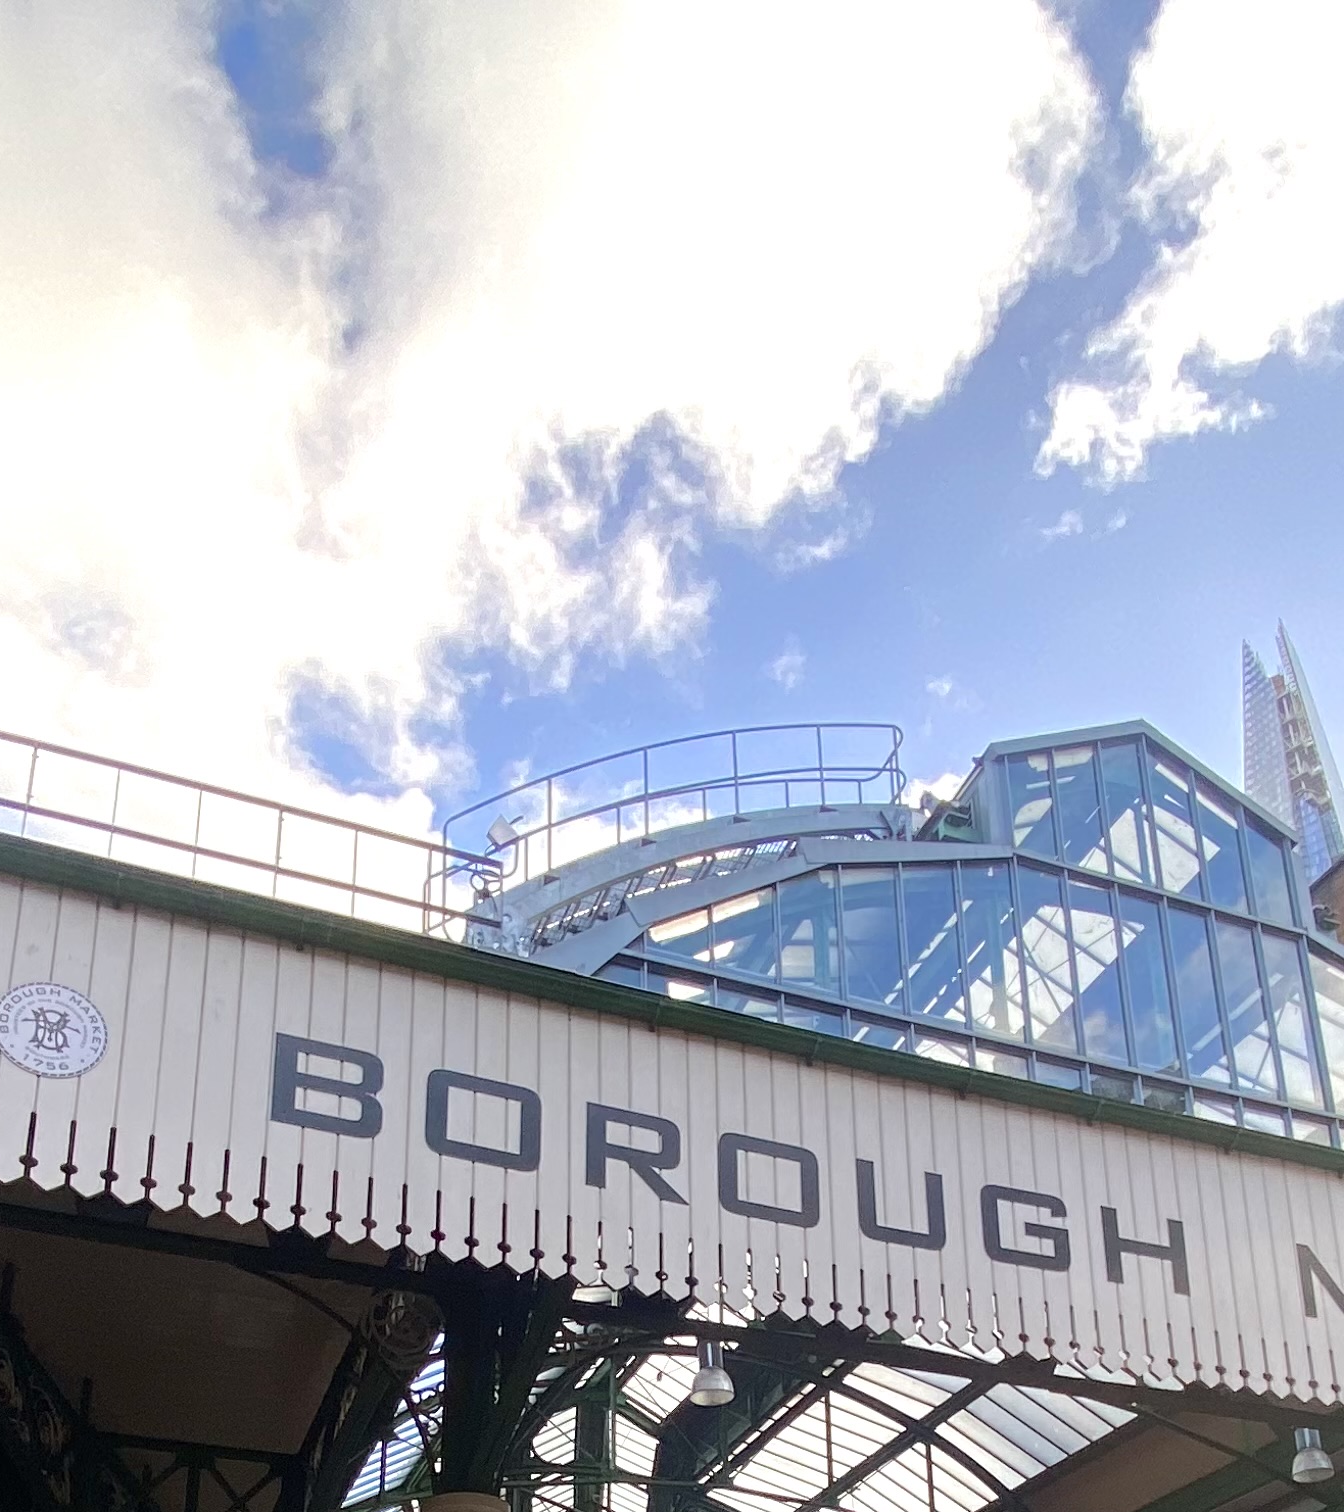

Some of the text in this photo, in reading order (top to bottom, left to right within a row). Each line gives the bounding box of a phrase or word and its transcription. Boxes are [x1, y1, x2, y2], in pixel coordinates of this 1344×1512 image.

[68, 995, 102, 1054] MARKET
[22, 1053, 70, 1071] 1756
[270, 1031, 1189, 1297] BOROUGH
